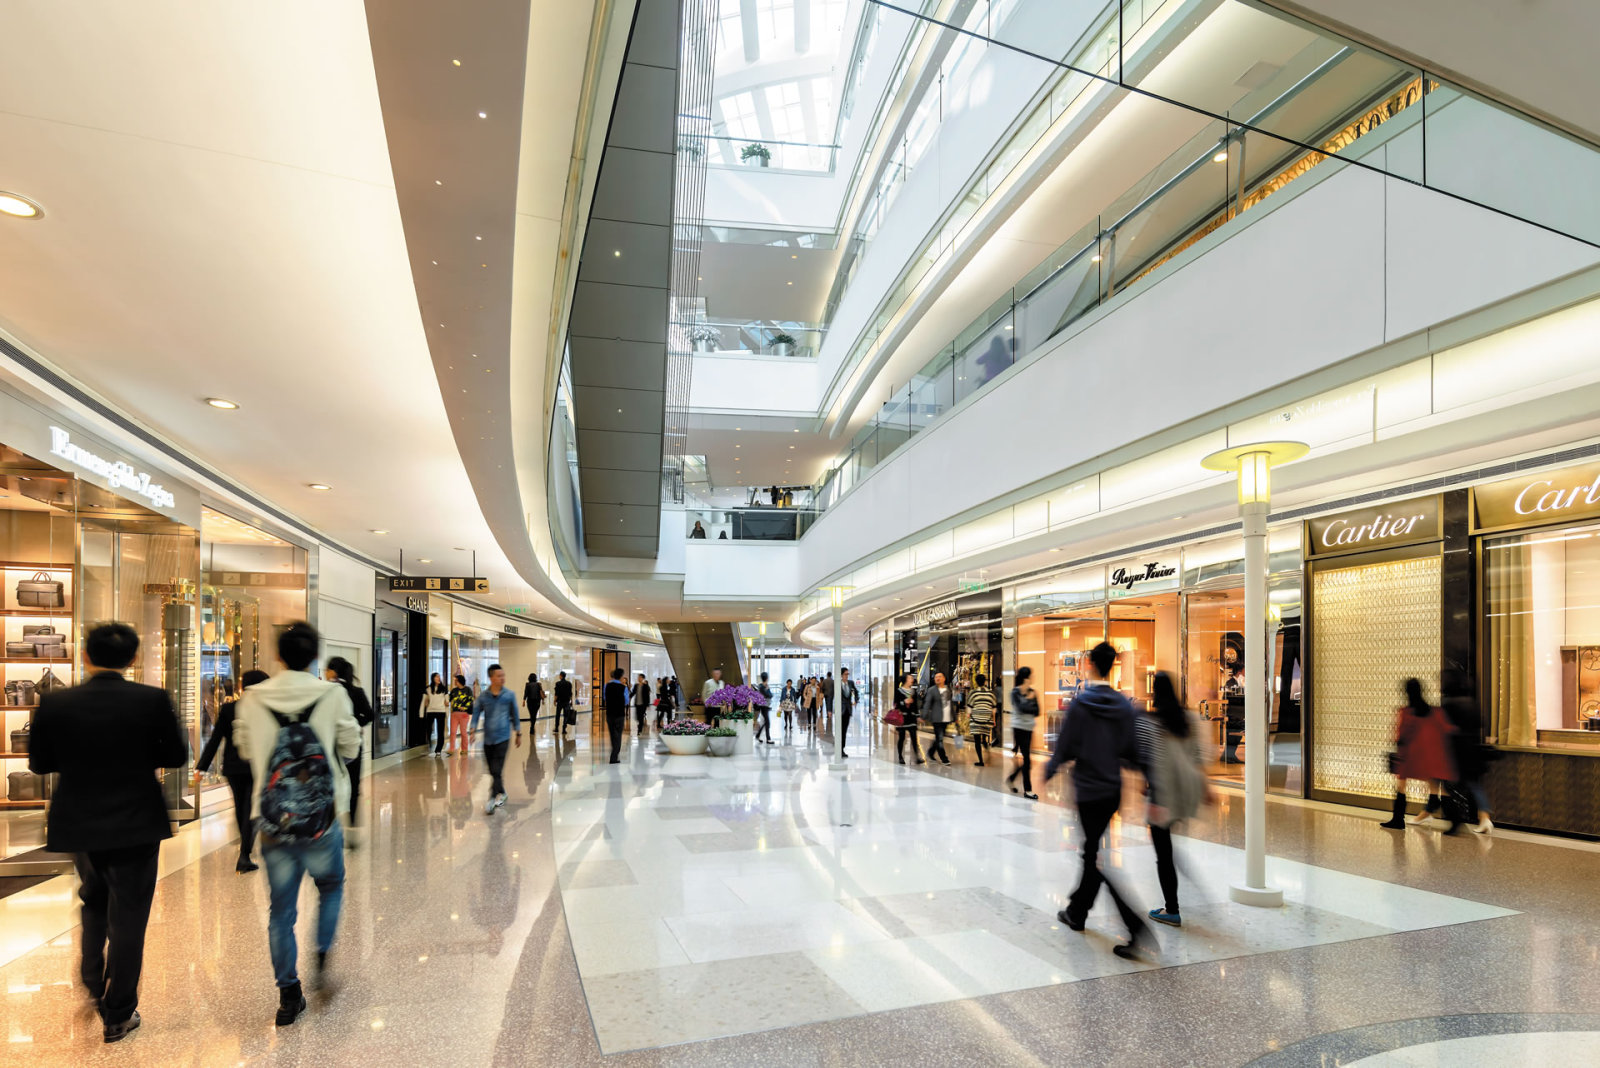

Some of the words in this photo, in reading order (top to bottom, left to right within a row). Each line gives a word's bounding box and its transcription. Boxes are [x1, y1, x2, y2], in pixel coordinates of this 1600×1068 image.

[1322, 514, 1424, 547] Cartier
[393, 579, 415, 587] EXIT
[406, 596, 428, 613] CHANE
